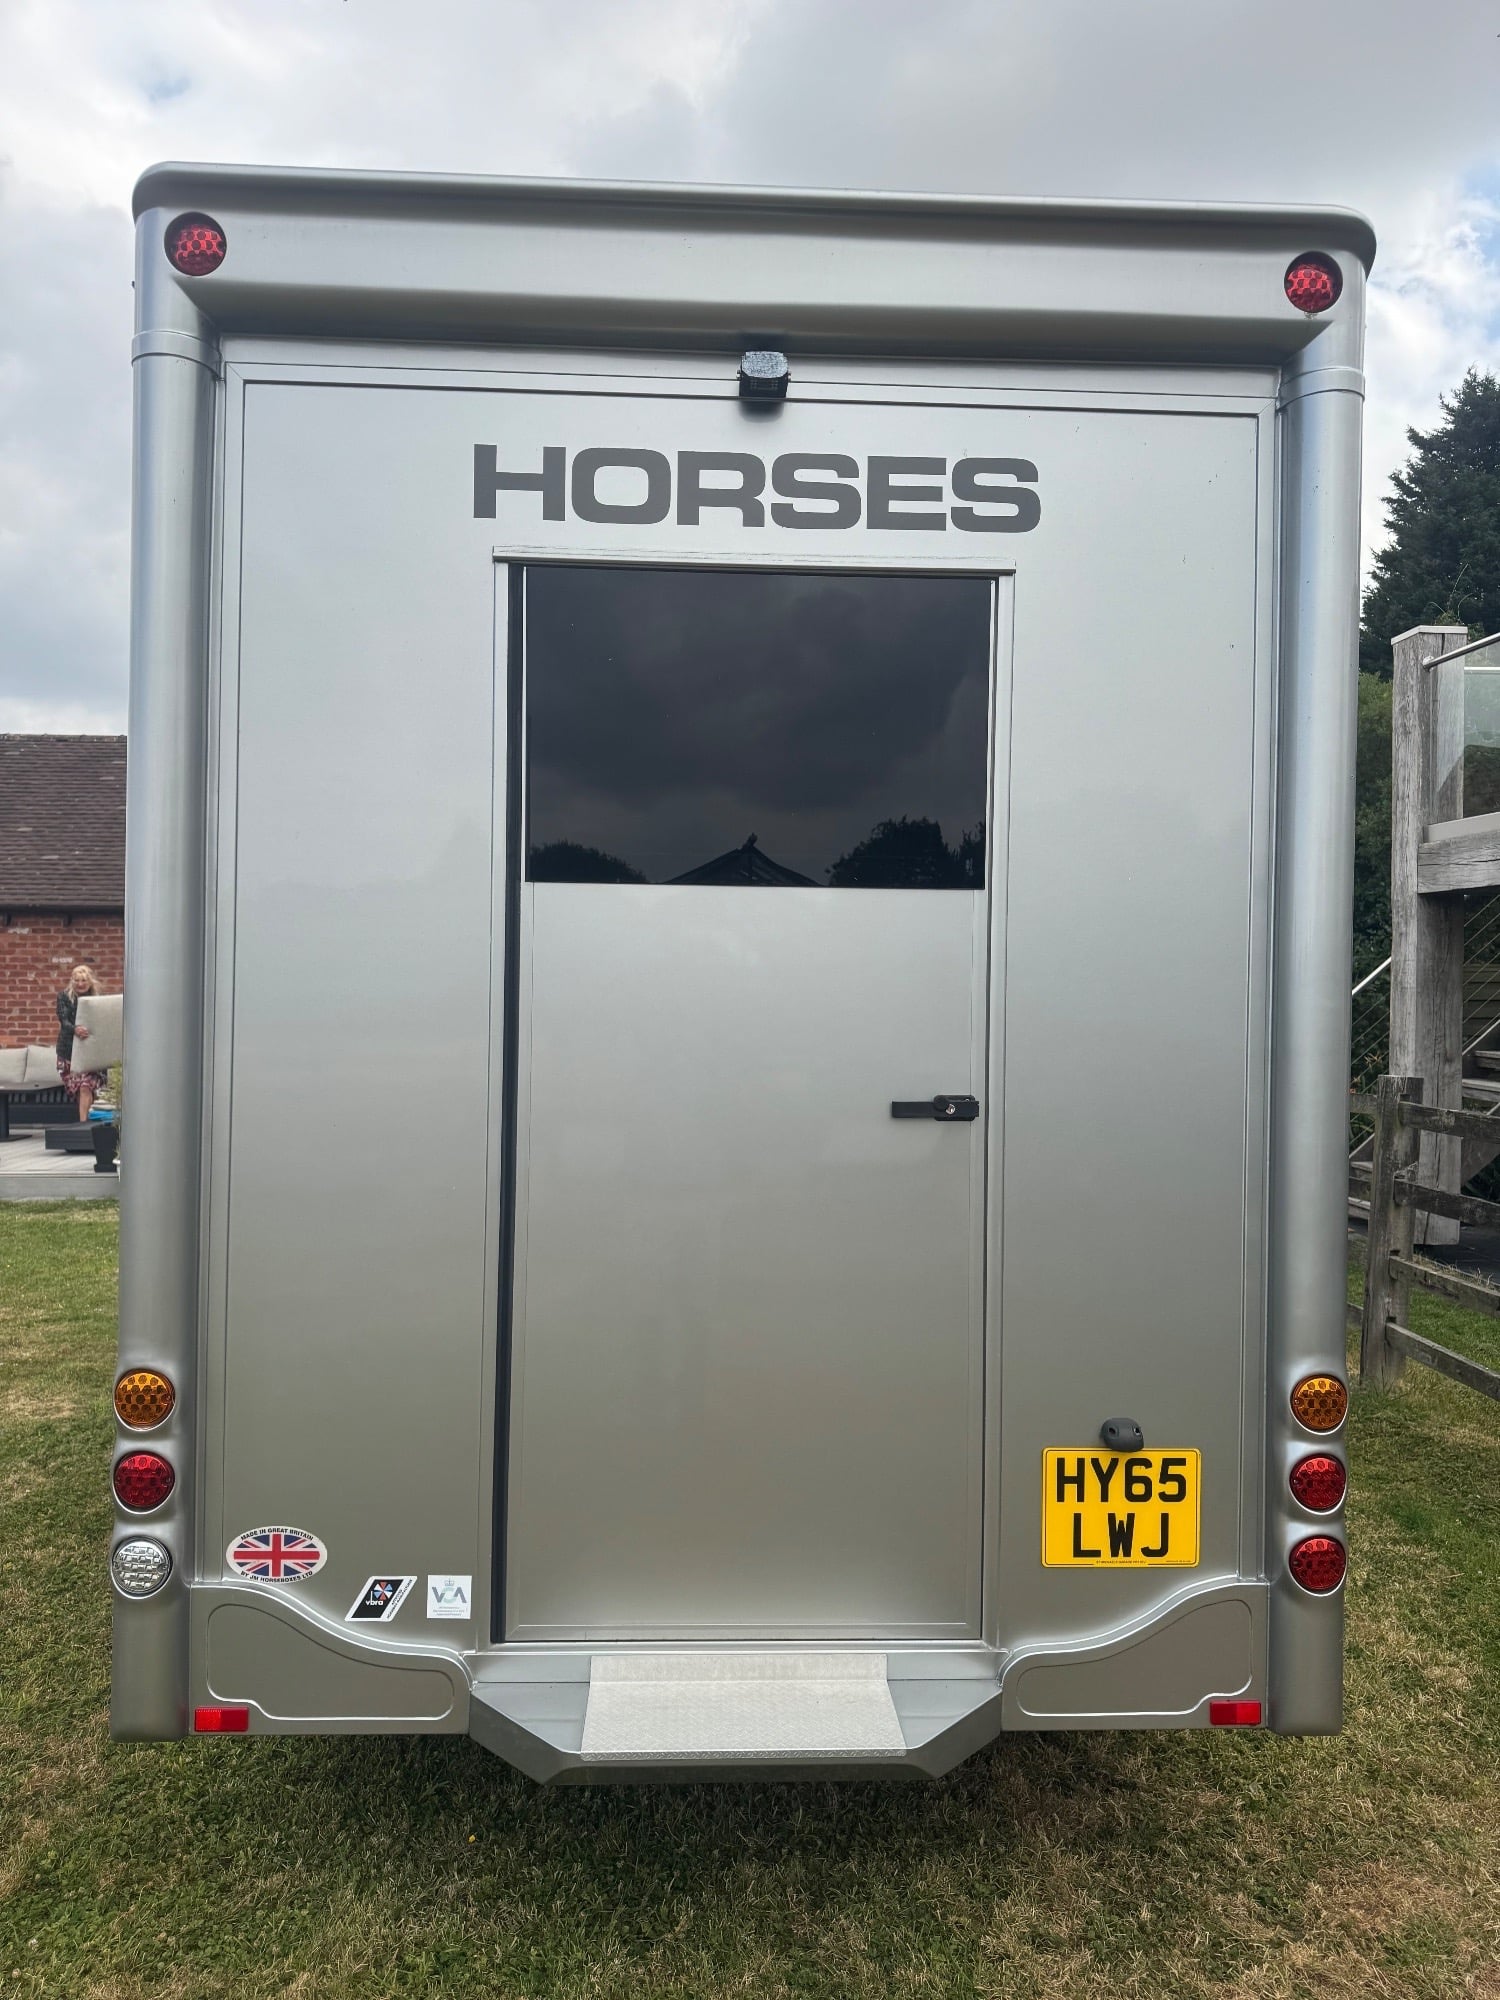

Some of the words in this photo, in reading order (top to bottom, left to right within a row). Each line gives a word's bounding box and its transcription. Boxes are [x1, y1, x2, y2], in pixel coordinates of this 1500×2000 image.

[473, 444, 1042, 533] HORSES
[1056, 1457, 1187, 1503] HY65
[241, 1530, 258, 1541] MADE
[289, 1529, 314, 1541] BRITAIN
[1072, 1512, 1169, 1558] LWJ
[302, 1570, 313, 1579] LTD
[365, 1590, 384, 1606] vbra
[432, 1586, 467, 1603] VCA
